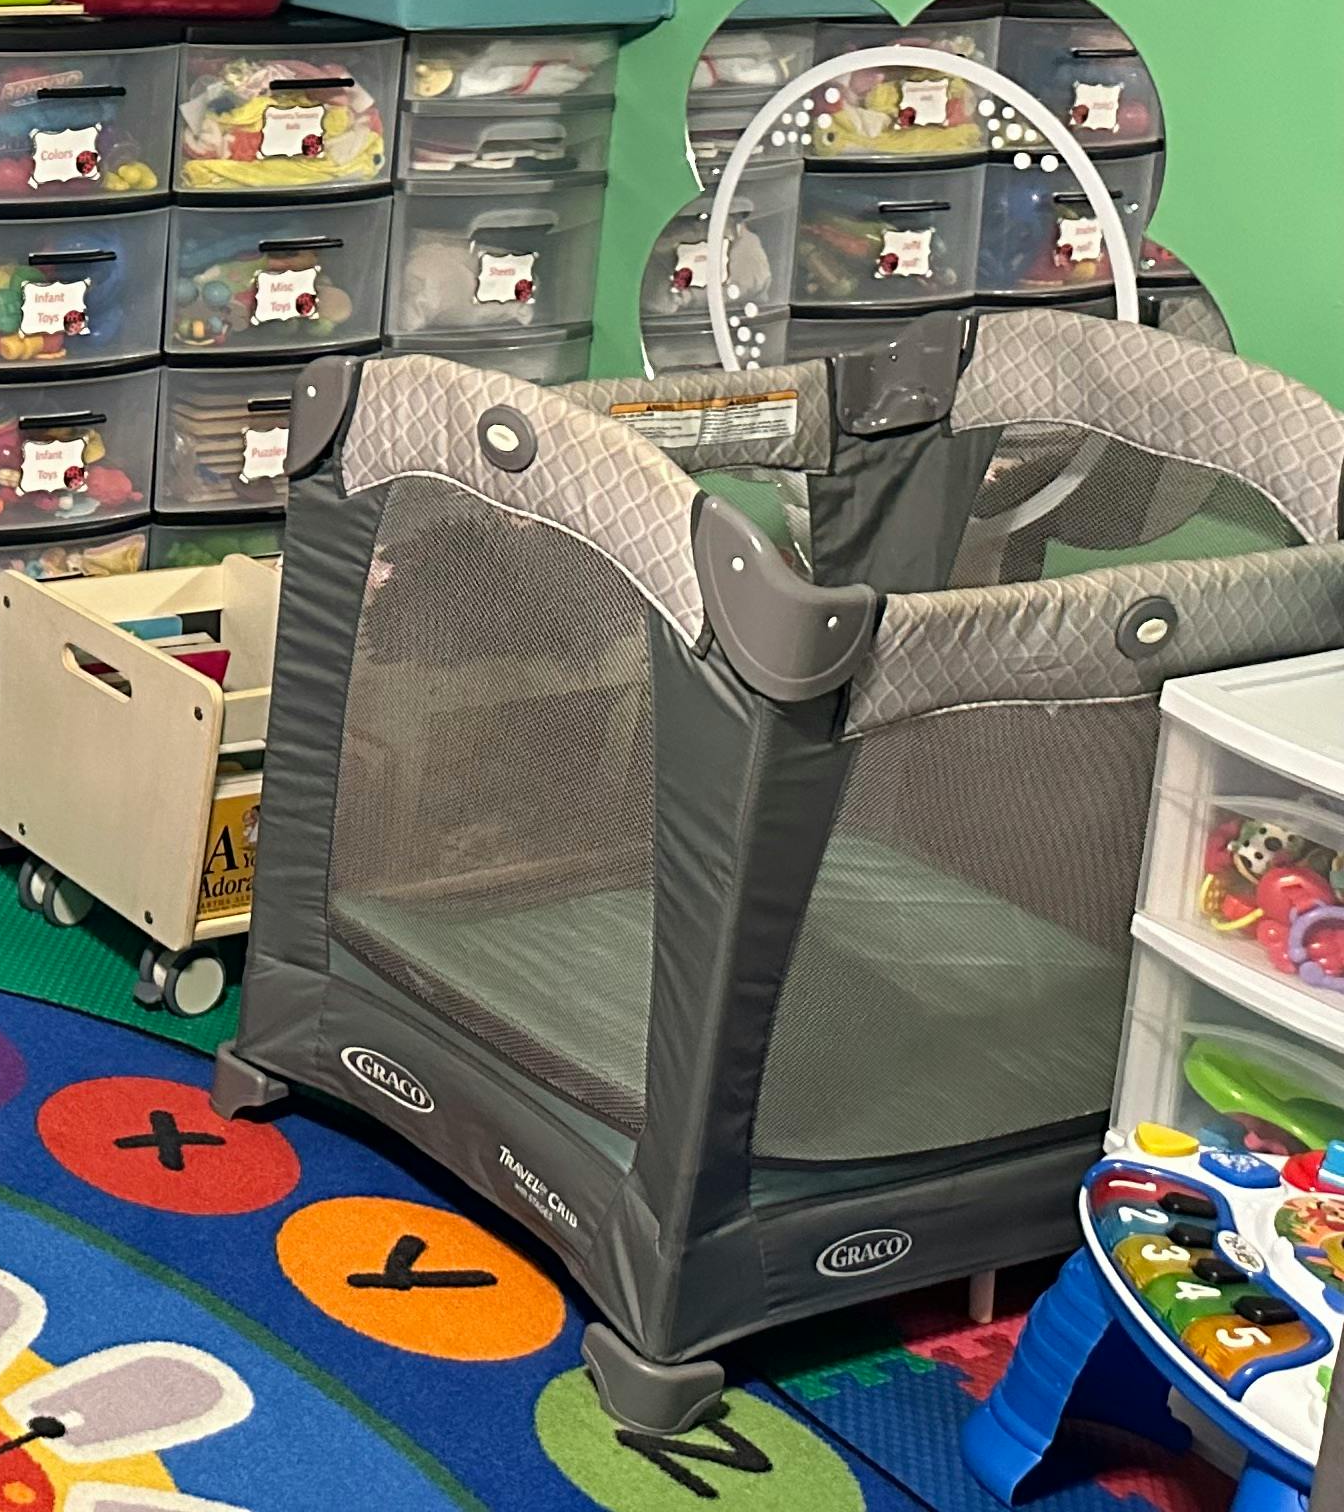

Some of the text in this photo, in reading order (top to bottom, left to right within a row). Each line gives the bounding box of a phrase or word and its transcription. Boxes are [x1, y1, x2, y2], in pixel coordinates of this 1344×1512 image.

[40, 149, 74, 161] Colors
[34, 292, 65, 303] Infant
[37, 312, 60, 324] Toys
[35, 449, 63, 461] Infant
[37, 470, 58, 482] Toys
[203, 824, 240, 875] A
[355, 1053, 426, 1107] GRACO
[498, 1144, 579, 1229] TRAVEL CRIB
[1108, 1179, 1157, 1192] 1
[1118, 1206, 1169, 1224] 2
[830, 1235, 904, 1268] GRACO
[1141, 1243, 1191, 1261] 3
[1175, 1281, 1222, 1300] 4
[1215, 1326, 1272, 1348] 5
